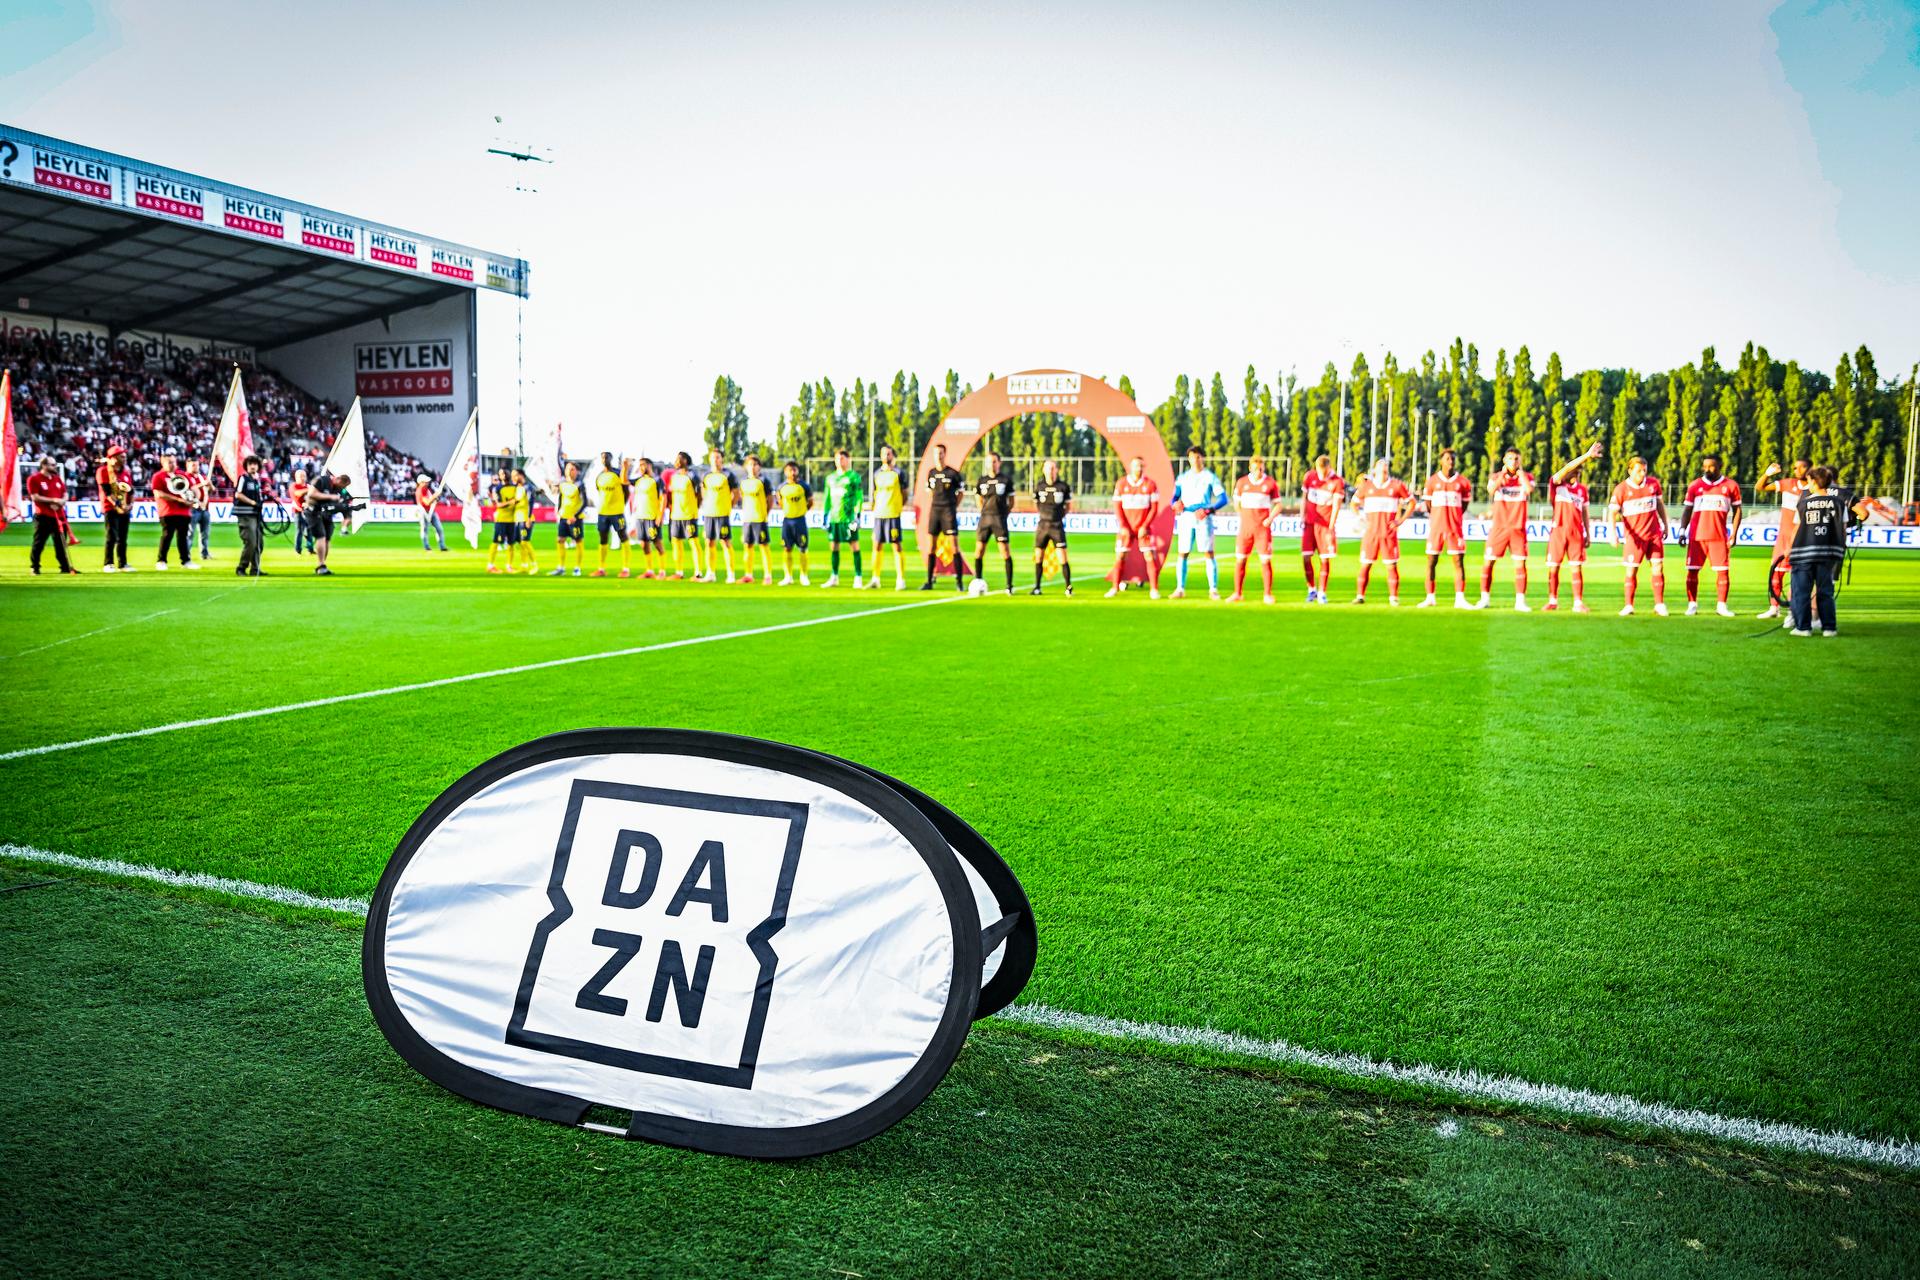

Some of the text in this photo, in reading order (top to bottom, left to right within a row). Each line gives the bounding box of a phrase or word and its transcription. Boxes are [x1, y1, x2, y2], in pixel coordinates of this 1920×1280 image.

[36, 150, 109, 182] HEYLEN
[36, 171, 110, 197] VASTGOED
[137, 176, 202, 204] HEYLEN
[136, 194, 203, 219] VASTGOED
[225, 198, 282, 224] HEYLEN
[225, 214, 283, 238] VASTGOED
[303, 217, 354, 240] HEYLEN
[371, 233, 417, 255] HEYLEN
[432, 249, 473, 268] HEYLEN
[358, 344, 449, 369] HEYLEN
[359, 376, 450, 391] VASTGOED
[1010, 377, 1078, 391] HEYLEN
[362, 401, 454, 415] ennis van wonen
[1807, 499, 1834, 510] MEDIA
